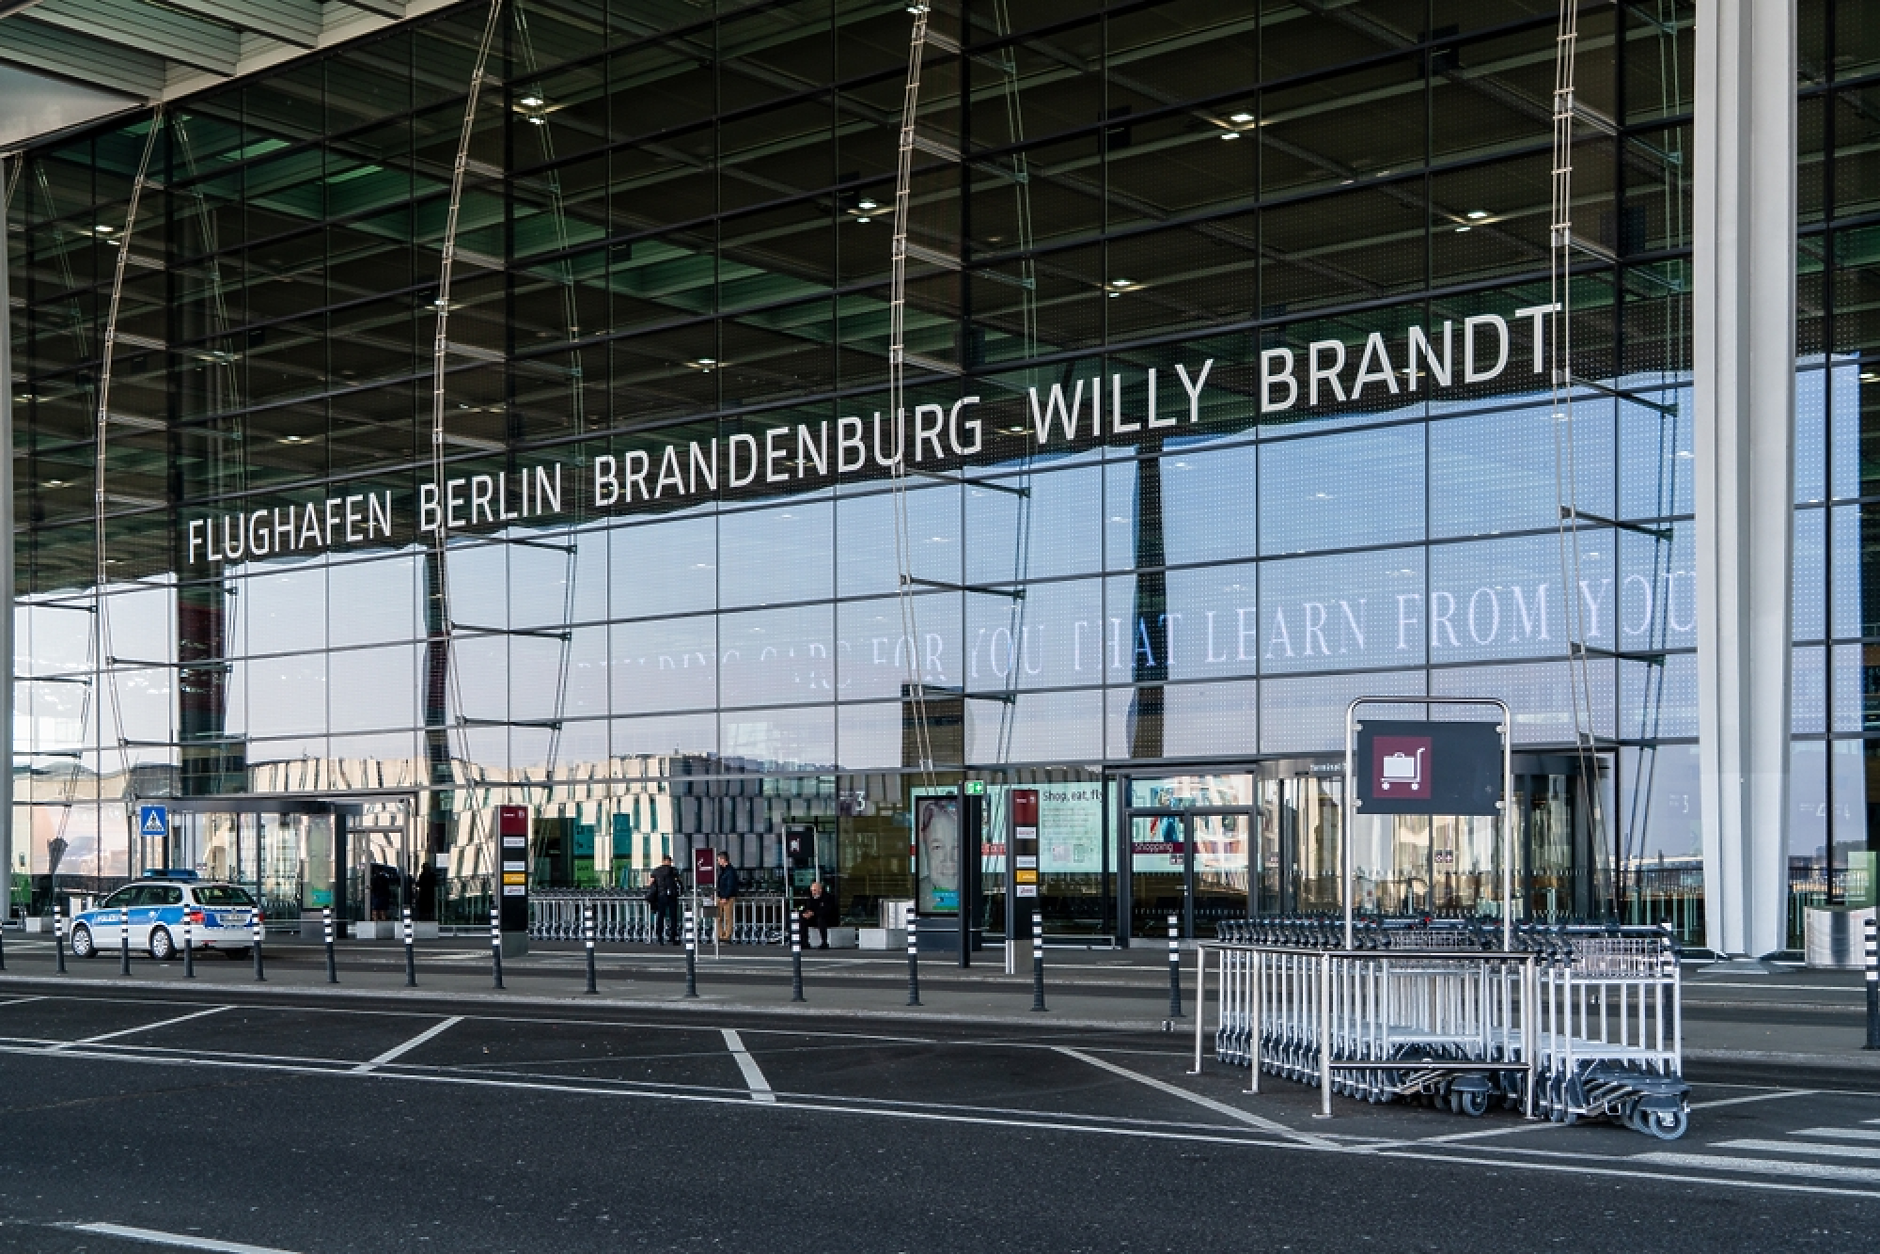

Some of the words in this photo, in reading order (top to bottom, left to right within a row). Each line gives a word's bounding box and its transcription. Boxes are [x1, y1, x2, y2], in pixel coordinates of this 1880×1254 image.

[189, 490, 393, 564] FLUGHAFEN
[420, 462, 562, 532] BERLIN
[595, 396, 982, 507] BRANDENBURG
[1029, 358, 1214, 444] WILLY
[1261, 302, 1562, 413] BRANDT
[1204, 599, 1368, 662] LEARN
[1396, 582, 1550, 650] FROM
[1579, 572, 1697, 636] YOU
